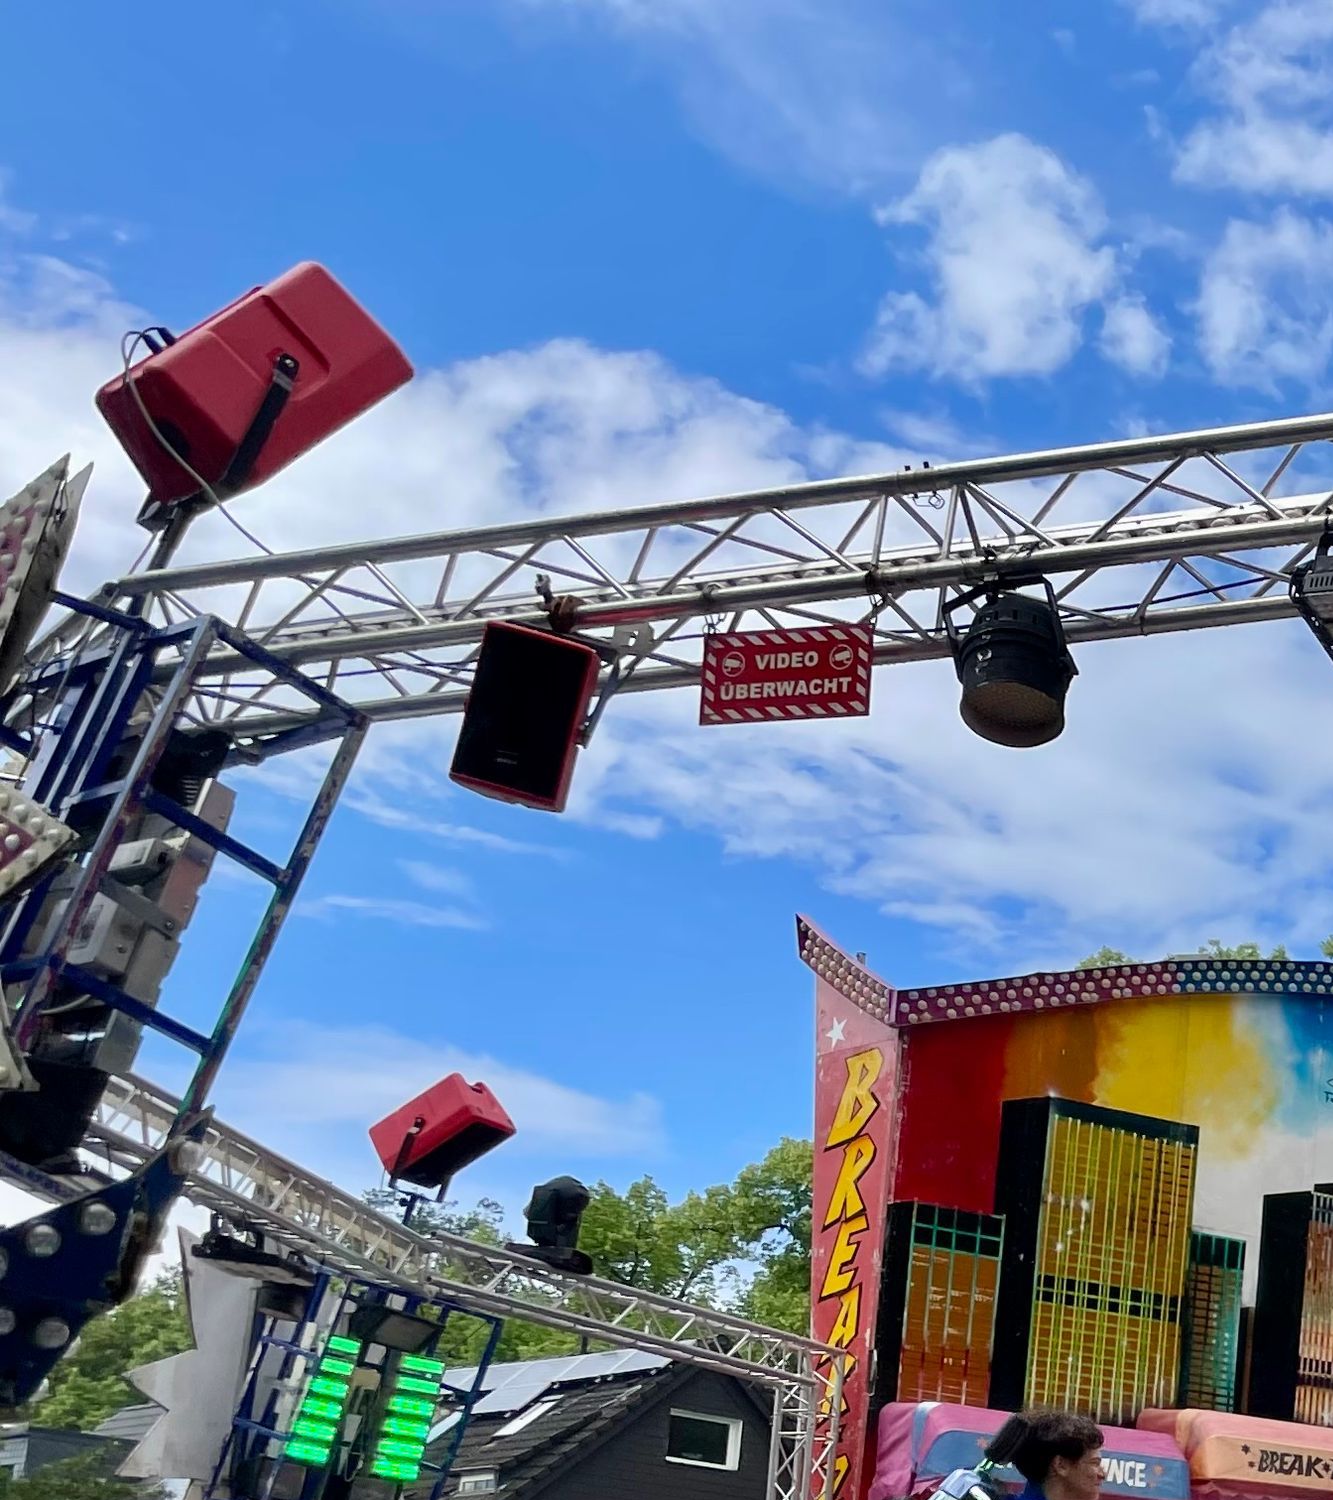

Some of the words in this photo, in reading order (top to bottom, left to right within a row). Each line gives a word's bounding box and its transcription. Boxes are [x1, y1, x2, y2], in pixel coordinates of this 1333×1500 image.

[754, 650, 819, 671] VIDEO
[719, 676, 853, 702] ÜBERWACHT
[1257, 1449, 1324, 1479] BREAK
